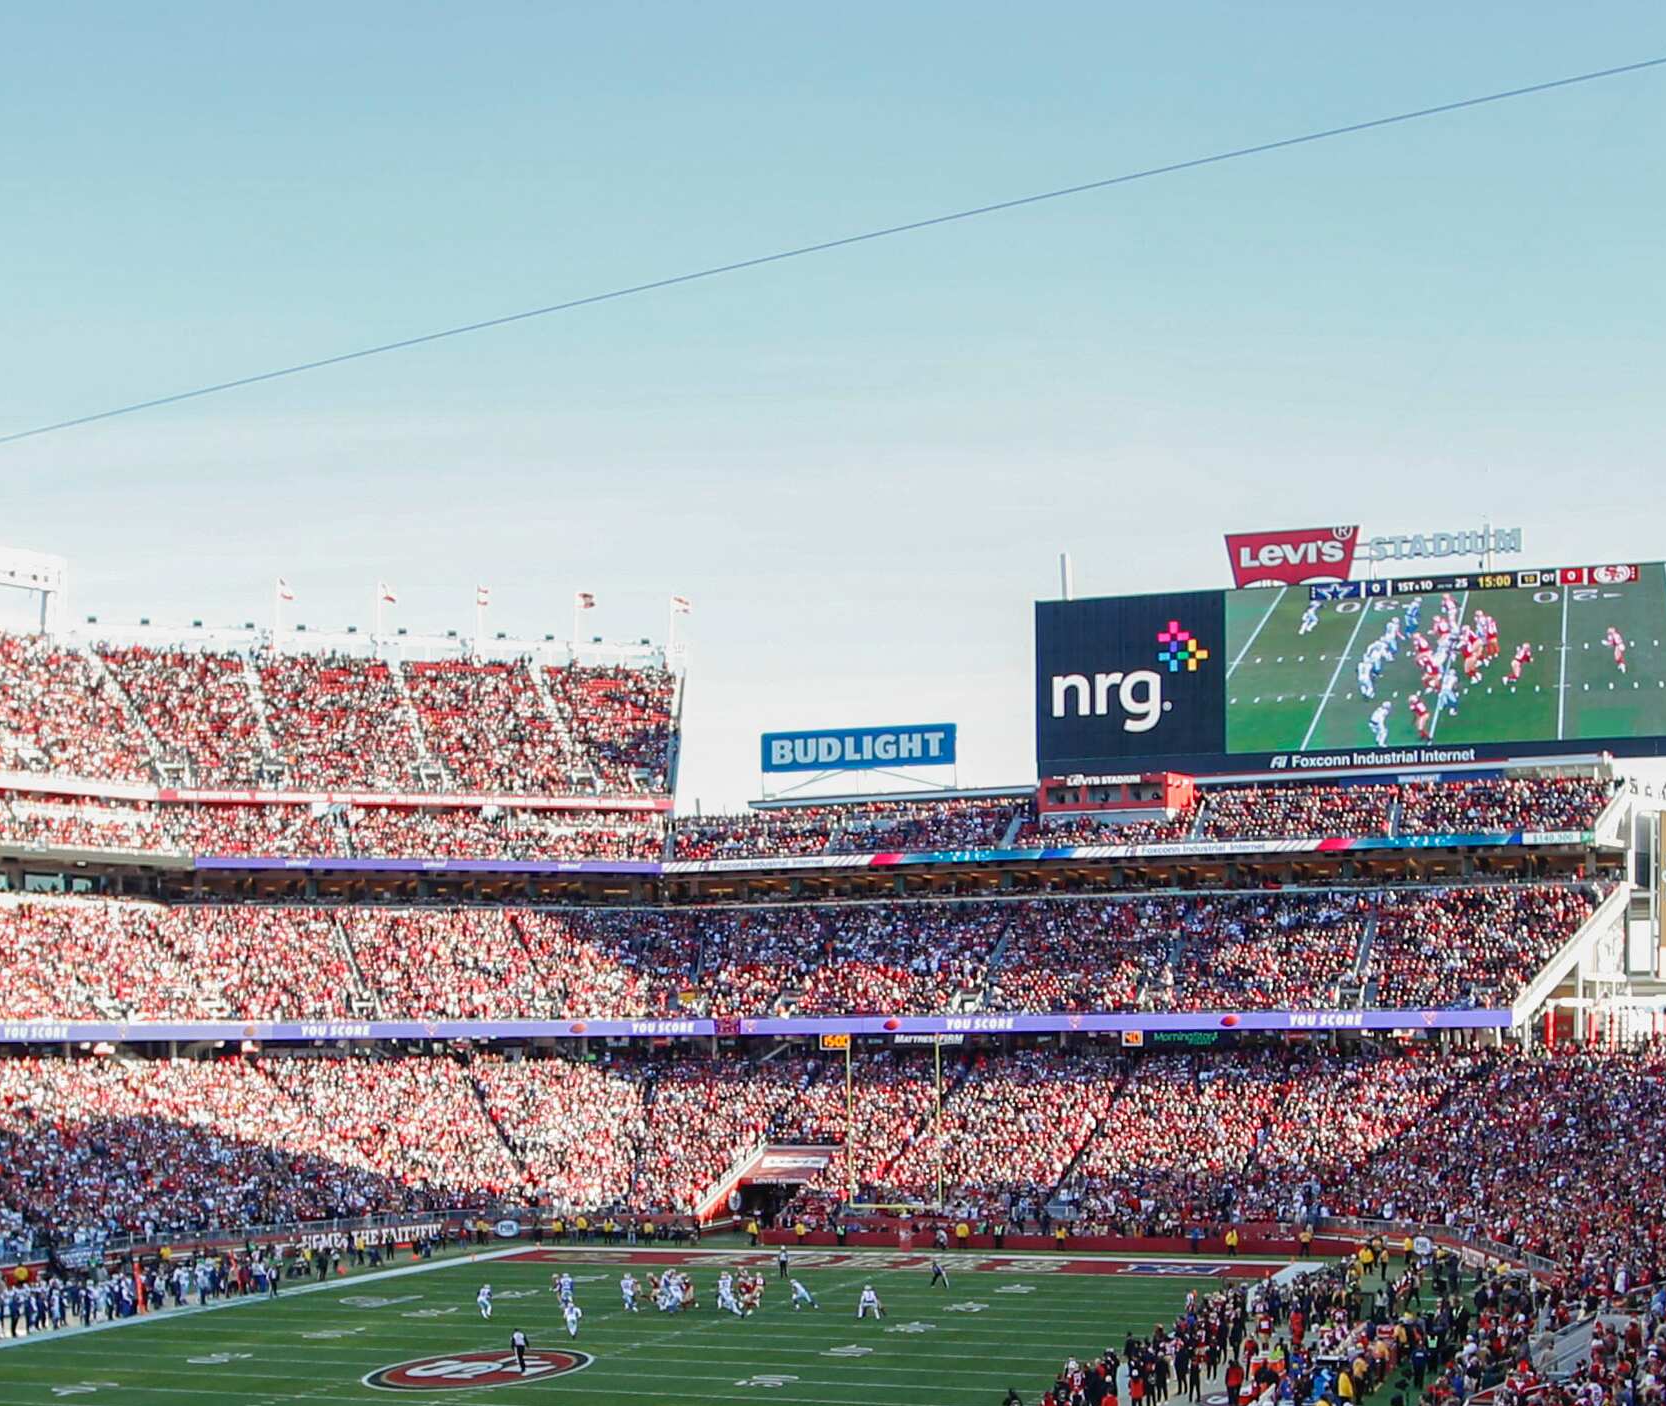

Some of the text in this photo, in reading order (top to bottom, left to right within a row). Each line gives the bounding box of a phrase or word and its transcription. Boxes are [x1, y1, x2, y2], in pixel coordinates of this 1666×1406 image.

[1369, 527, 1523, 561] STADIUM
[1477, 575, 1511, 588] 15:00
[771, 732, 945, 765] BUD LIGHT
[1291, 748, 1477, 768] Foxconn Industrial Internet
[1141, 841, 1266, 855] Foxconn Industrial Internet
[632, 1020, 695, 1035] YOU SCORE
[946, 1016, 1014, 1031] YOU SCORE
[1289, 1013, 1363, 1027] YOU SCORE
[300, 1022, 371, 1038] YOU SCORE
[500, 1223, 514, 1233] FOX
